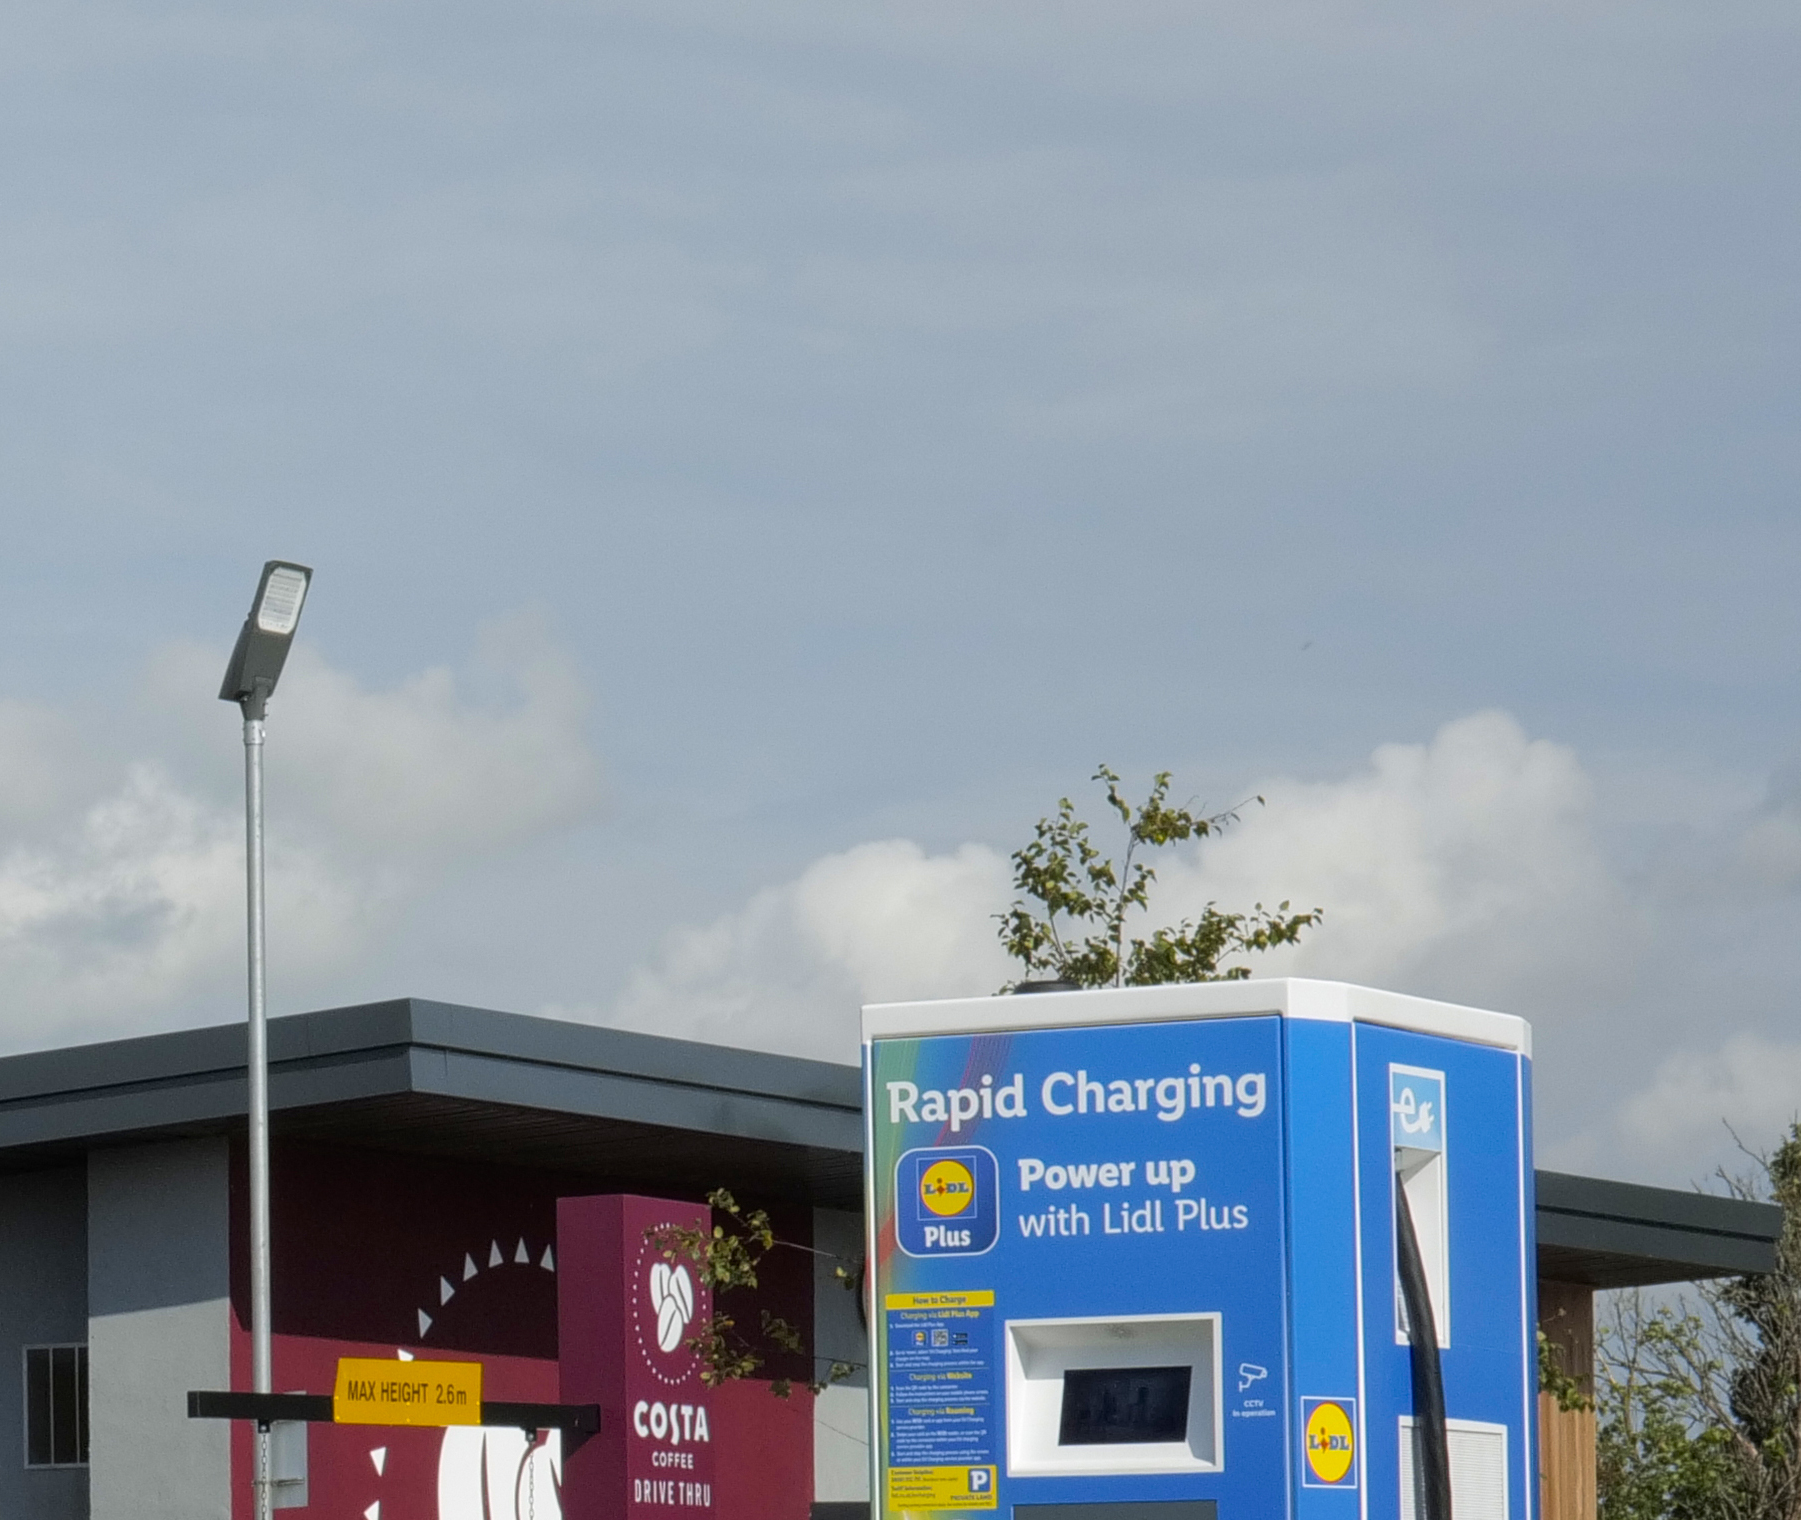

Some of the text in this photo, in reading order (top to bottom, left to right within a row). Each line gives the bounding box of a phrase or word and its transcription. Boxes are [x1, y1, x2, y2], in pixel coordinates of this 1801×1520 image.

[886, 1064, 1266, 1131] Rapid Charging
[1018, 1155, 1196, 1192] Power up
[1019, 1198, 1248, 1238] with Lidl Plus
[924, 1225, 971, 1249] Plus
[913, 1297, 929, 1305] How
[347, 1380, 376, 1402] MAX
[381, 1381, 428, 1405] HEIGHT
[634, 1400, 709, 1446] COSTA
[1241, 1410, 1276, 1418] operation
[652, 1451, 694, 1470] COFFEE
[634, 1479, 711, 1507] DRIVE THRU
